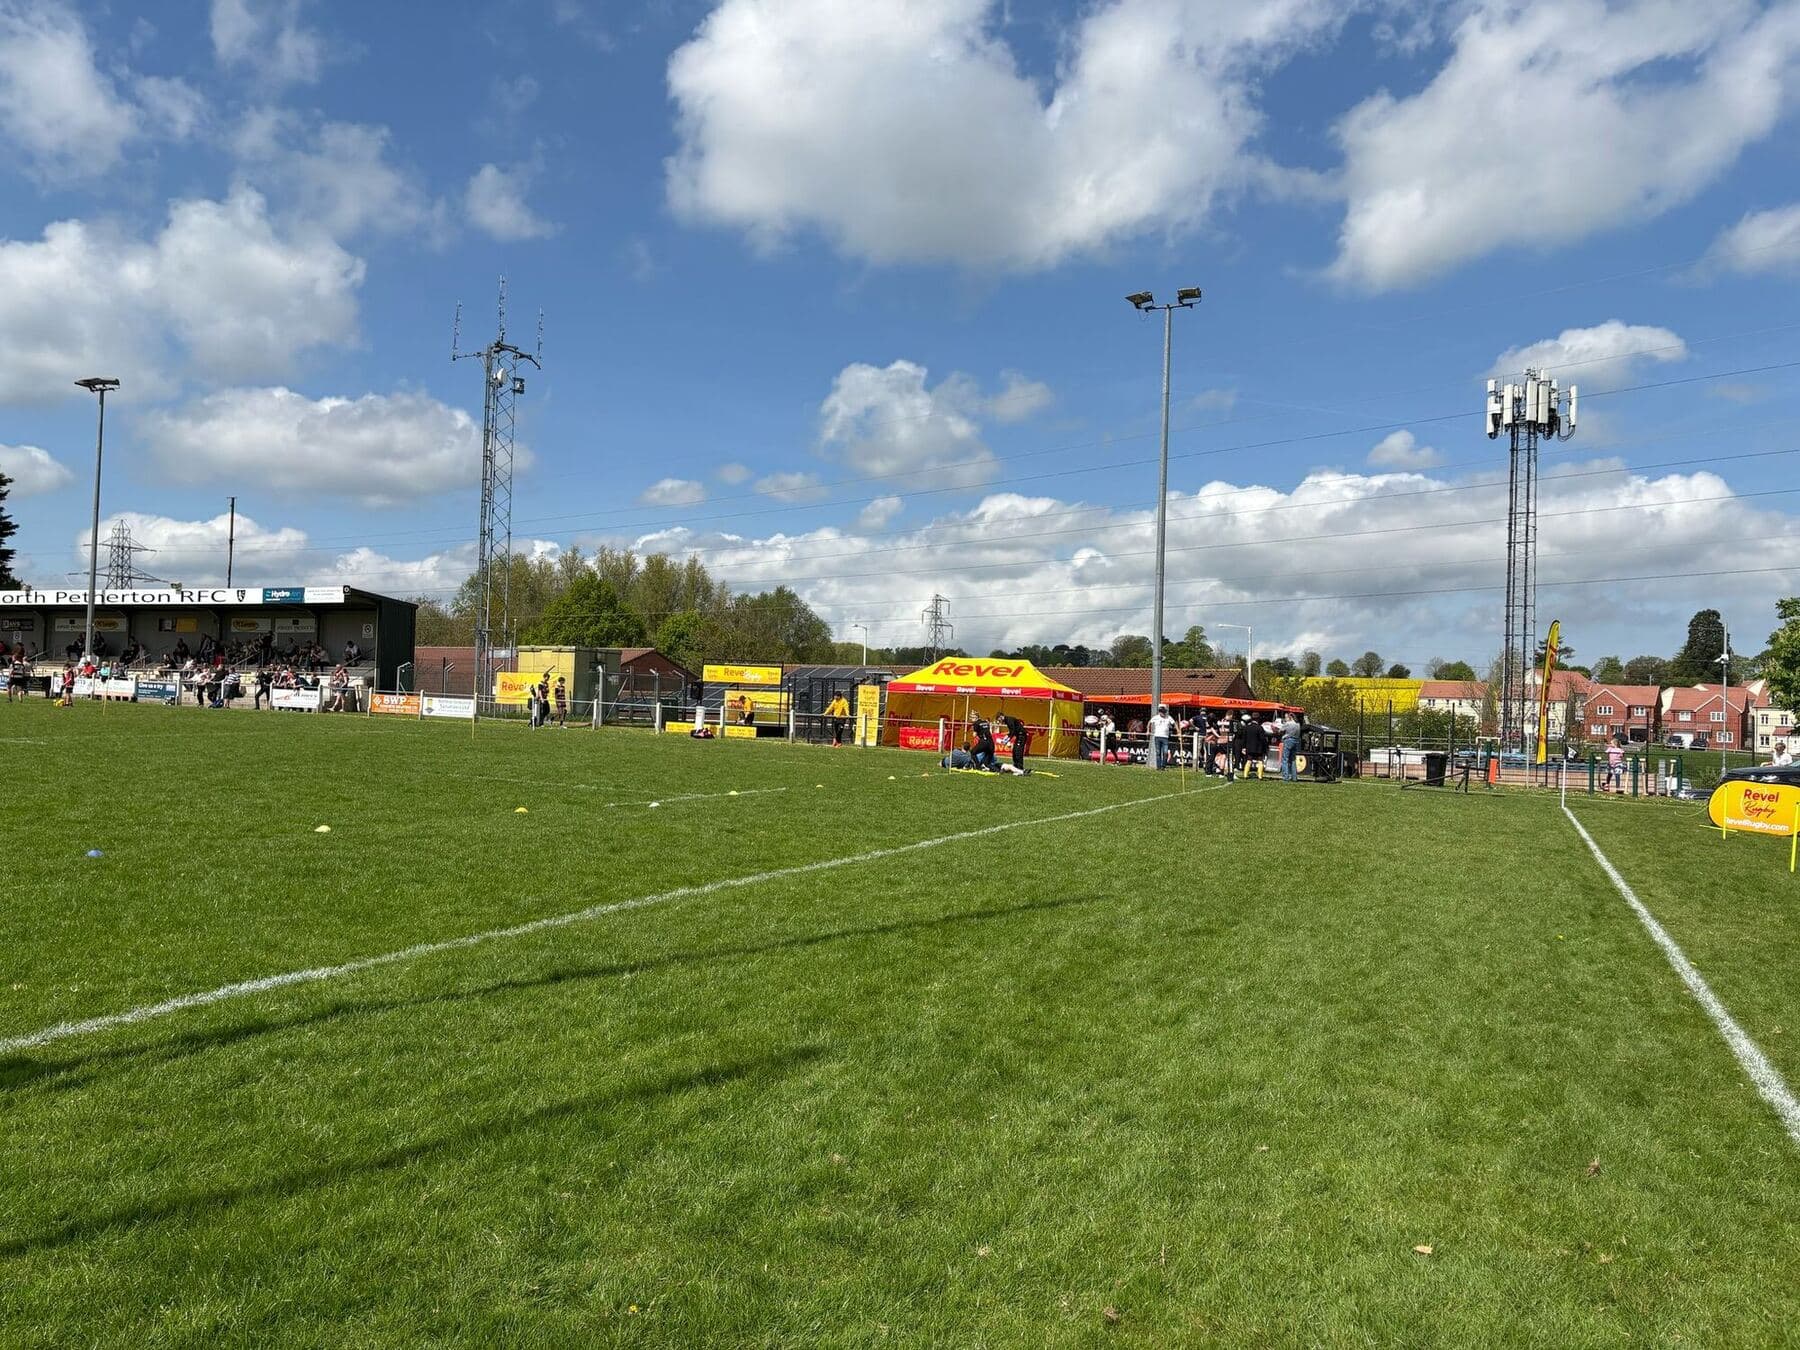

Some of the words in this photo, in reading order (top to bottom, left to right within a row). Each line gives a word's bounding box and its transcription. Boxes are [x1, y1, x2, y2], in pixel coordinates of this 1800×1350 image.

[180, 589, 227, 603] RFC
[932, 661, 1025, 678] Revel
[915, 684, 936, 692] Revel
[956, 686, 976, 694] Revel
[1001, 688, 1022, 696] Revel
[908, 736, 936, 746] Revel
[1743, 788, 1779, 803] Revel
[1744, 801, 1776, 818] Rugby
